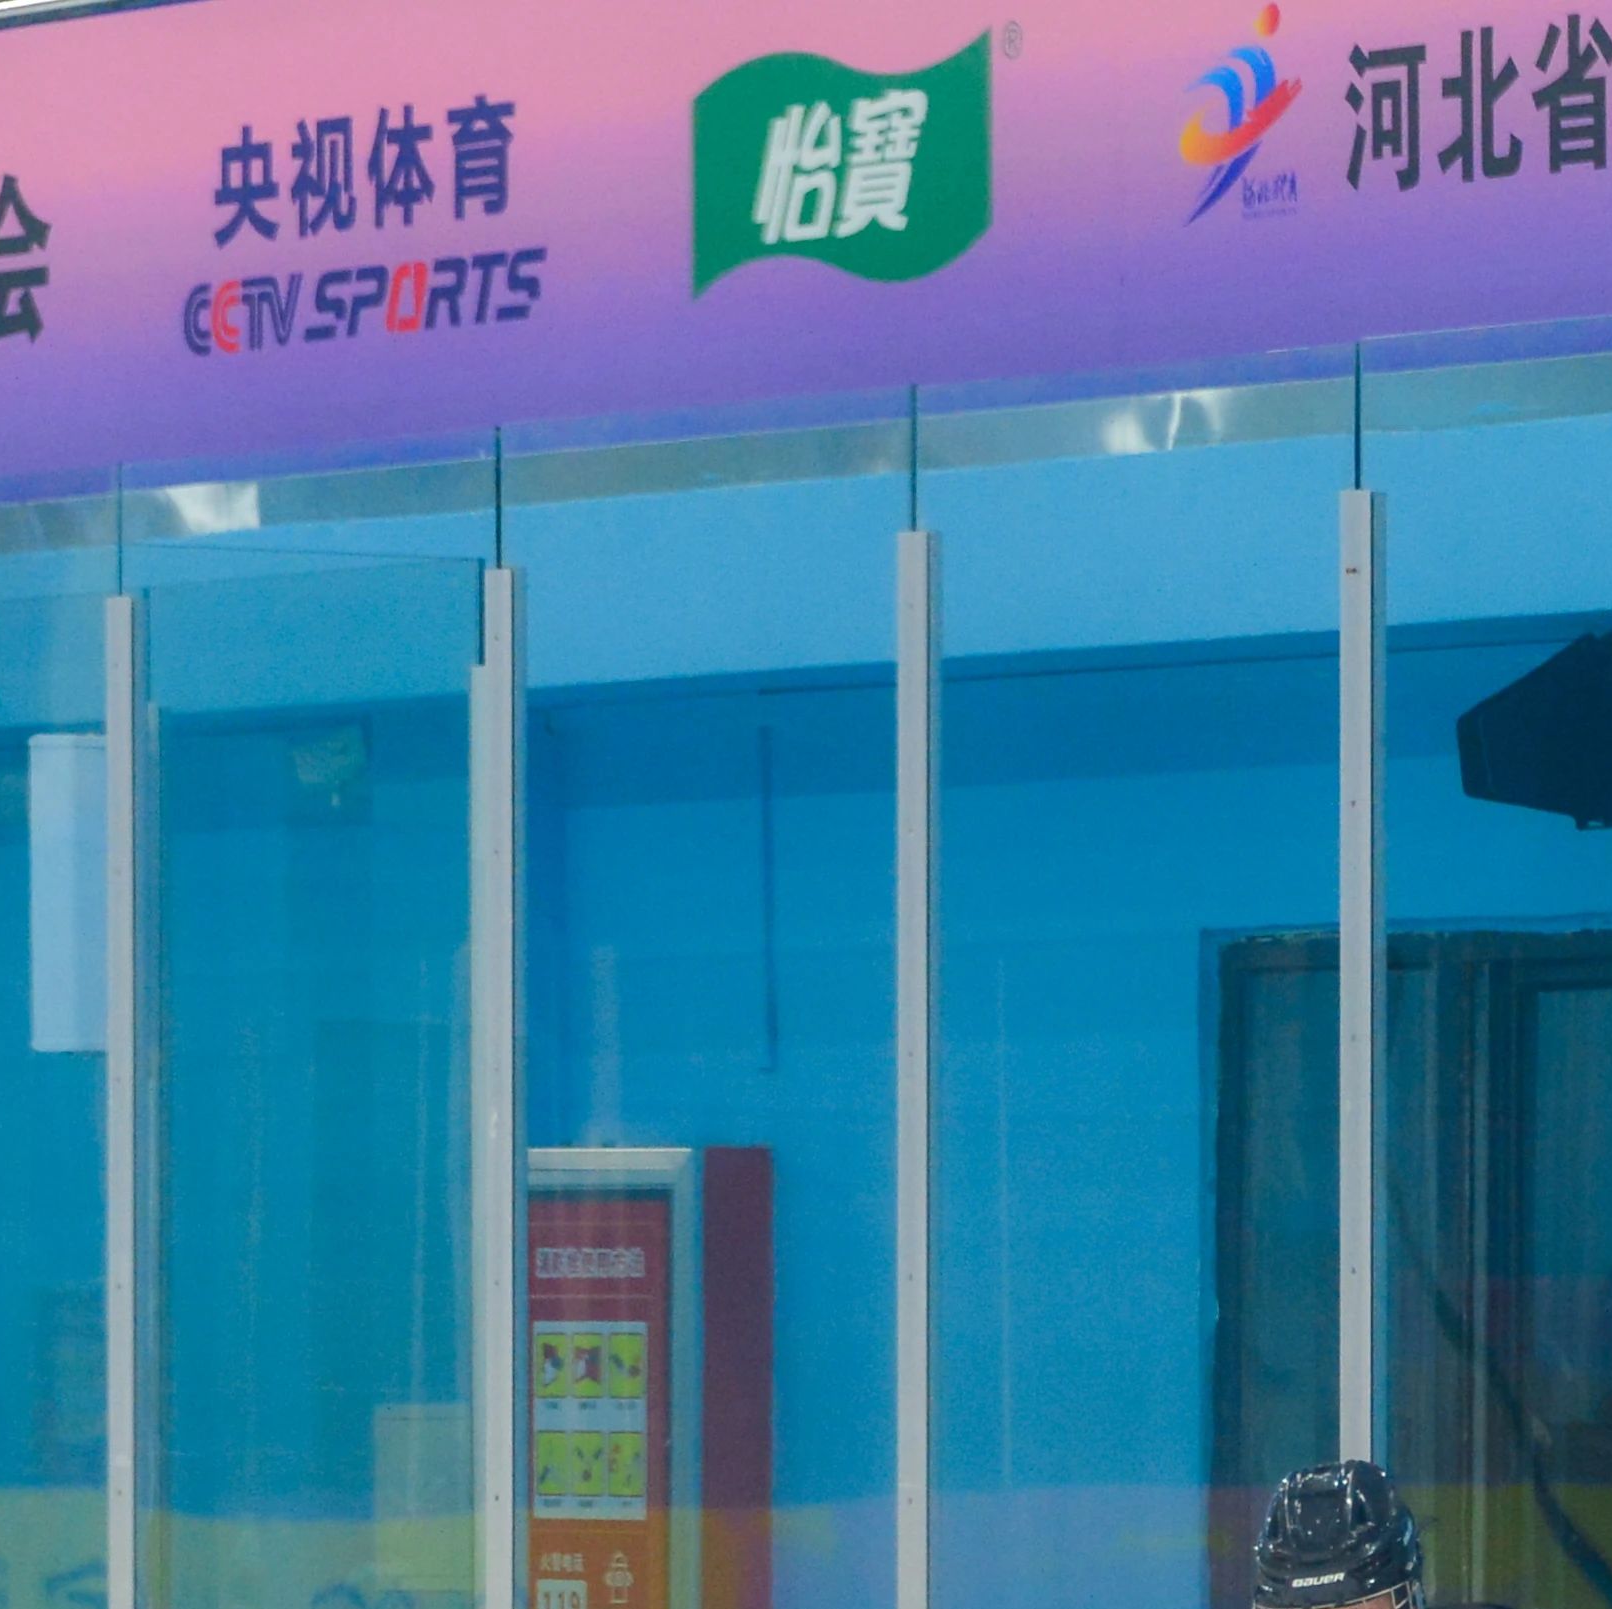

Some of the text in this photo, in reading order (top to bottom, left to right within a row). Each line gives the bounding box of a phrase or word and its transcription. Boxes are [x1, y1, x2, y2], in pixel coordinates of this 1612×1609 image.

[213, 95, 517, 248] 央视体育
[751, 88, 929, 245] 怡寶
[303, 248, 547, 345] SPORTS
[1291, 1572, 1346, 1588] BAUER
